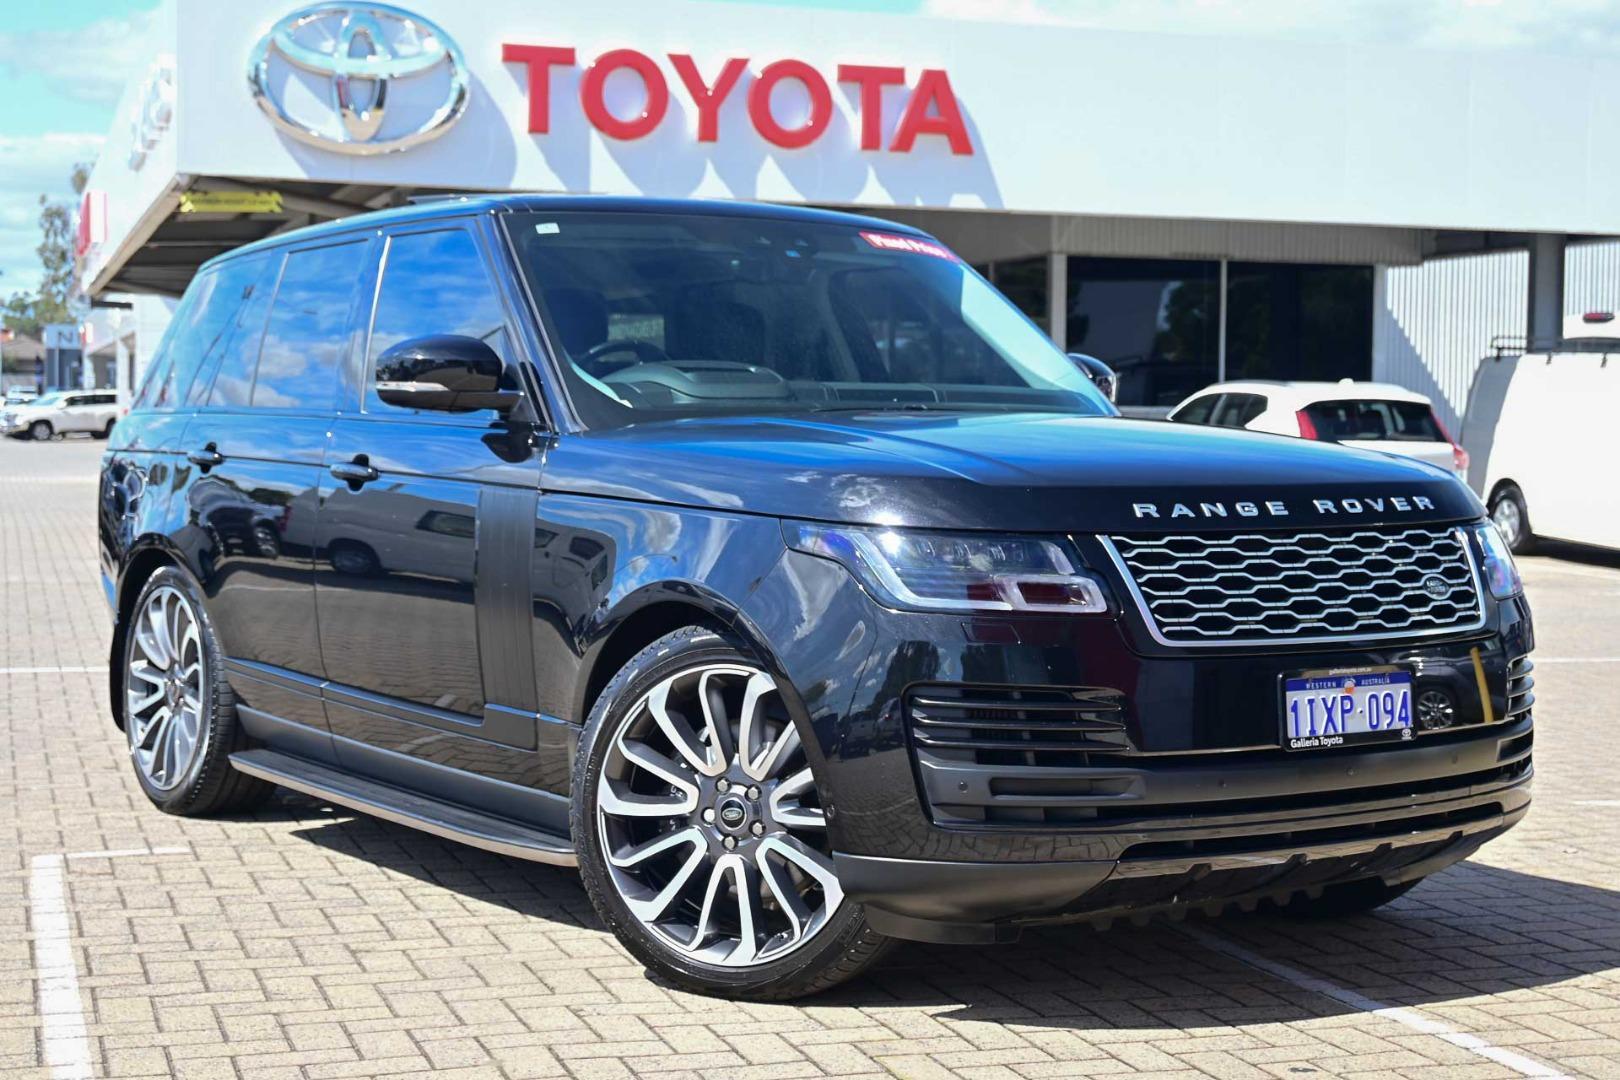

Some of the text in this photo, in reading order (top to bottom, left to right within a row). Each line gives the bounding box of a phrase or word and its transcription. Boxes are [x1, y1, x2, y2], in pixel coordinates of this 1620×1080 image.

[501, 43, 974, 156] TOYOTA
[1132, 495, 1435, 518] RANGE ROVER
[1305, 677, 1390, 690] WESTERN AUSTRALIA
[1290, 735, 1344, 749] Galleria Toyota
